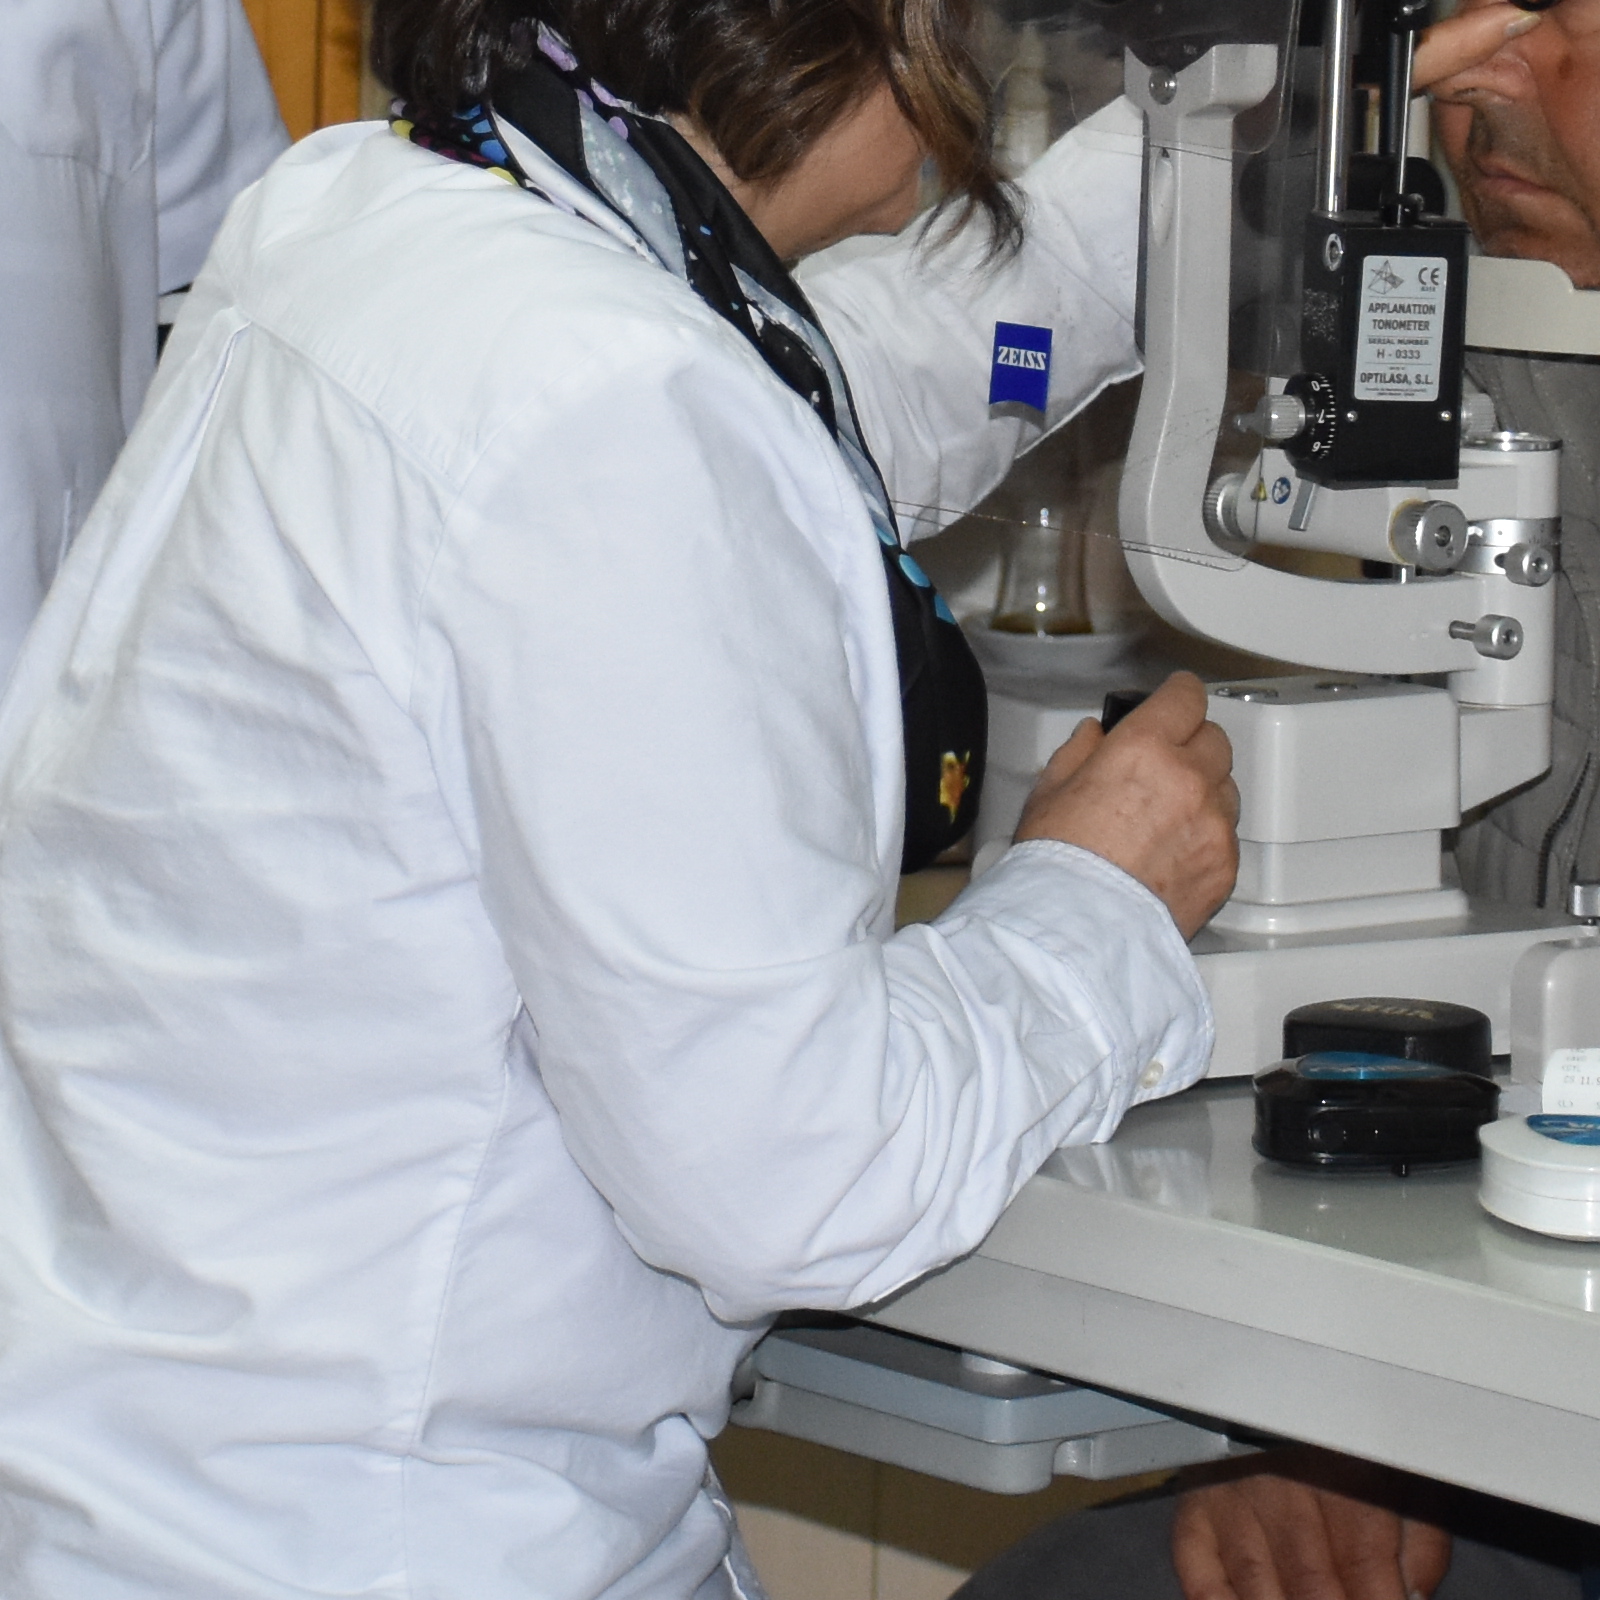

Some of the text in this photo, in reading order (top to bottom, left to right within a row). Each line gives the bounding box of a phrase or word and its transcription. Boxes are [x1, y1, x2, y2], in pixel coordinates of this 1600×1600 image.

[1368, 302, 1436, 315] APPLANATION
[1372, 319, 1430, 331] TONOMETER
[1397, 338, 1429, 346] NUMBER
[997, 345, 1047, 370] ZEISS
[1376, 349, 1385, 359] H
